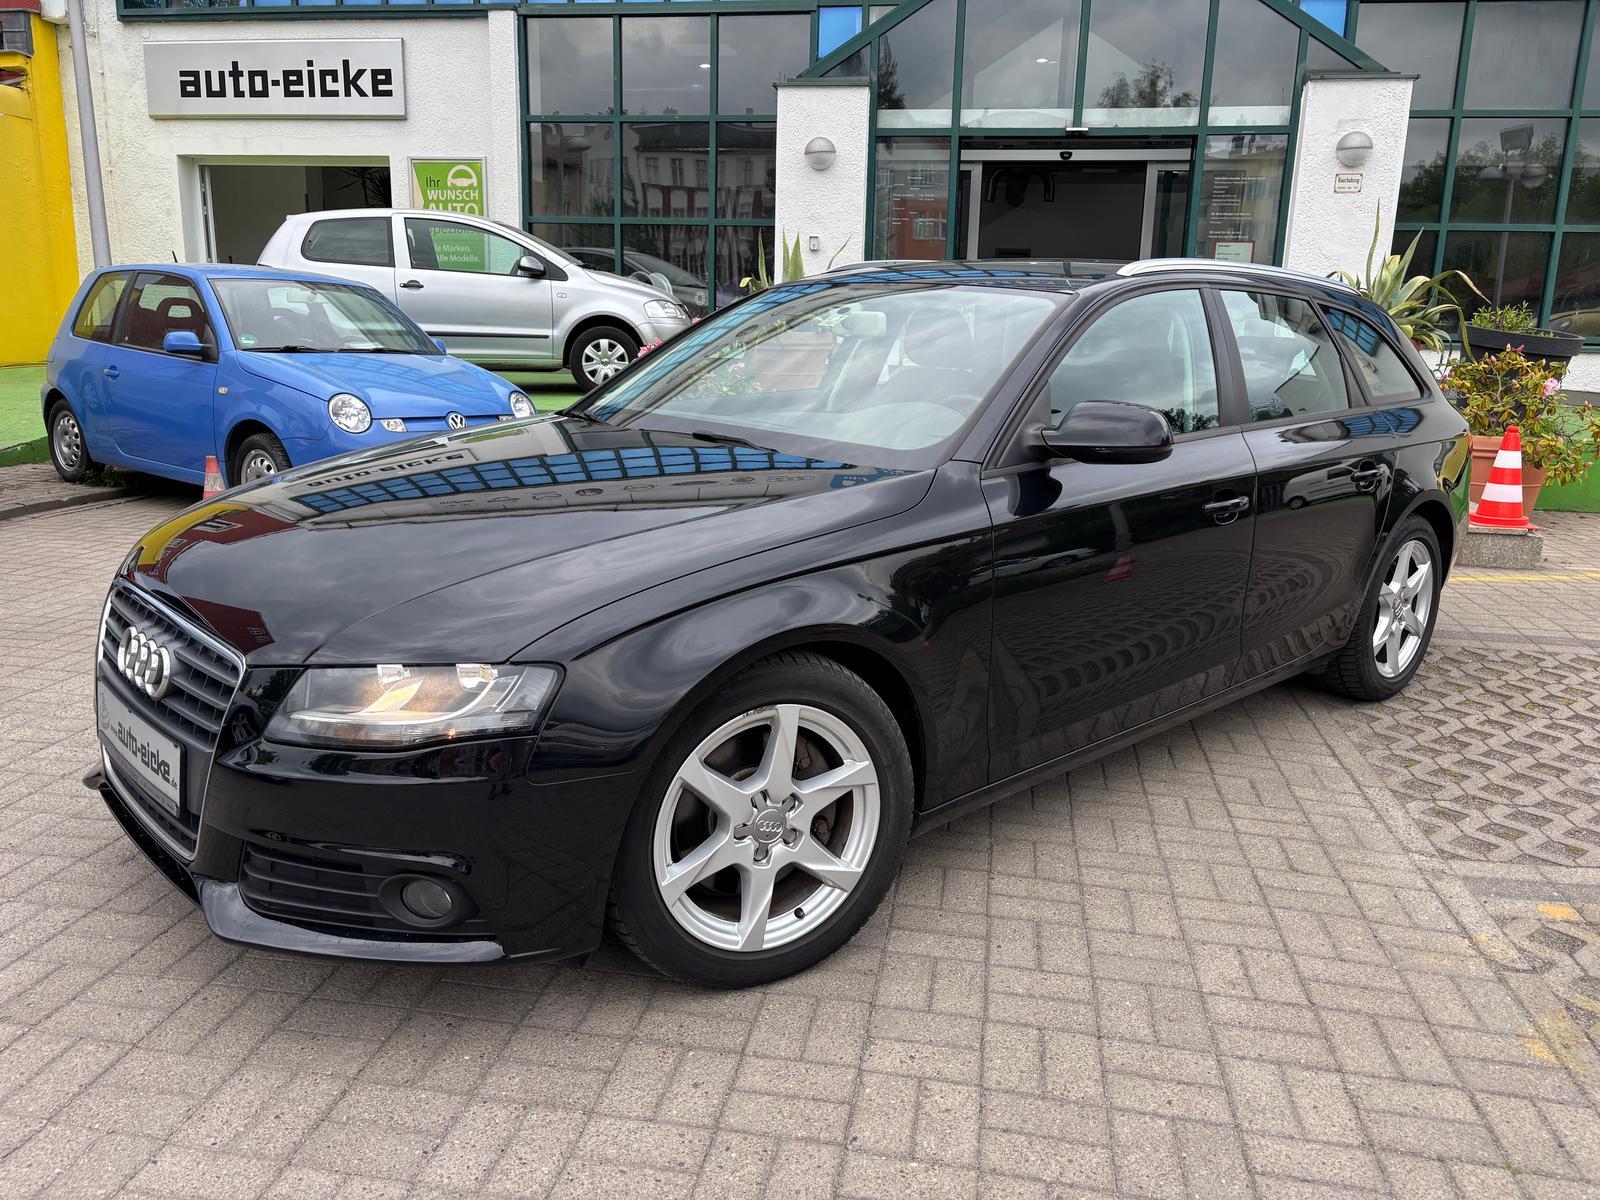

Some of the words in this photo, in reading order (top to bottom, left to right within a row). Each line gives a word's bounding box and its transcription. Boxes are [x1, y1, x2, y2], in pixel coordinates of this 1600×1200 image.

[179, 59, 393, 98] auto-eicke
[426, 177, 440, 188] Ihr
[427, 189, 479, 200] WUNSCH
